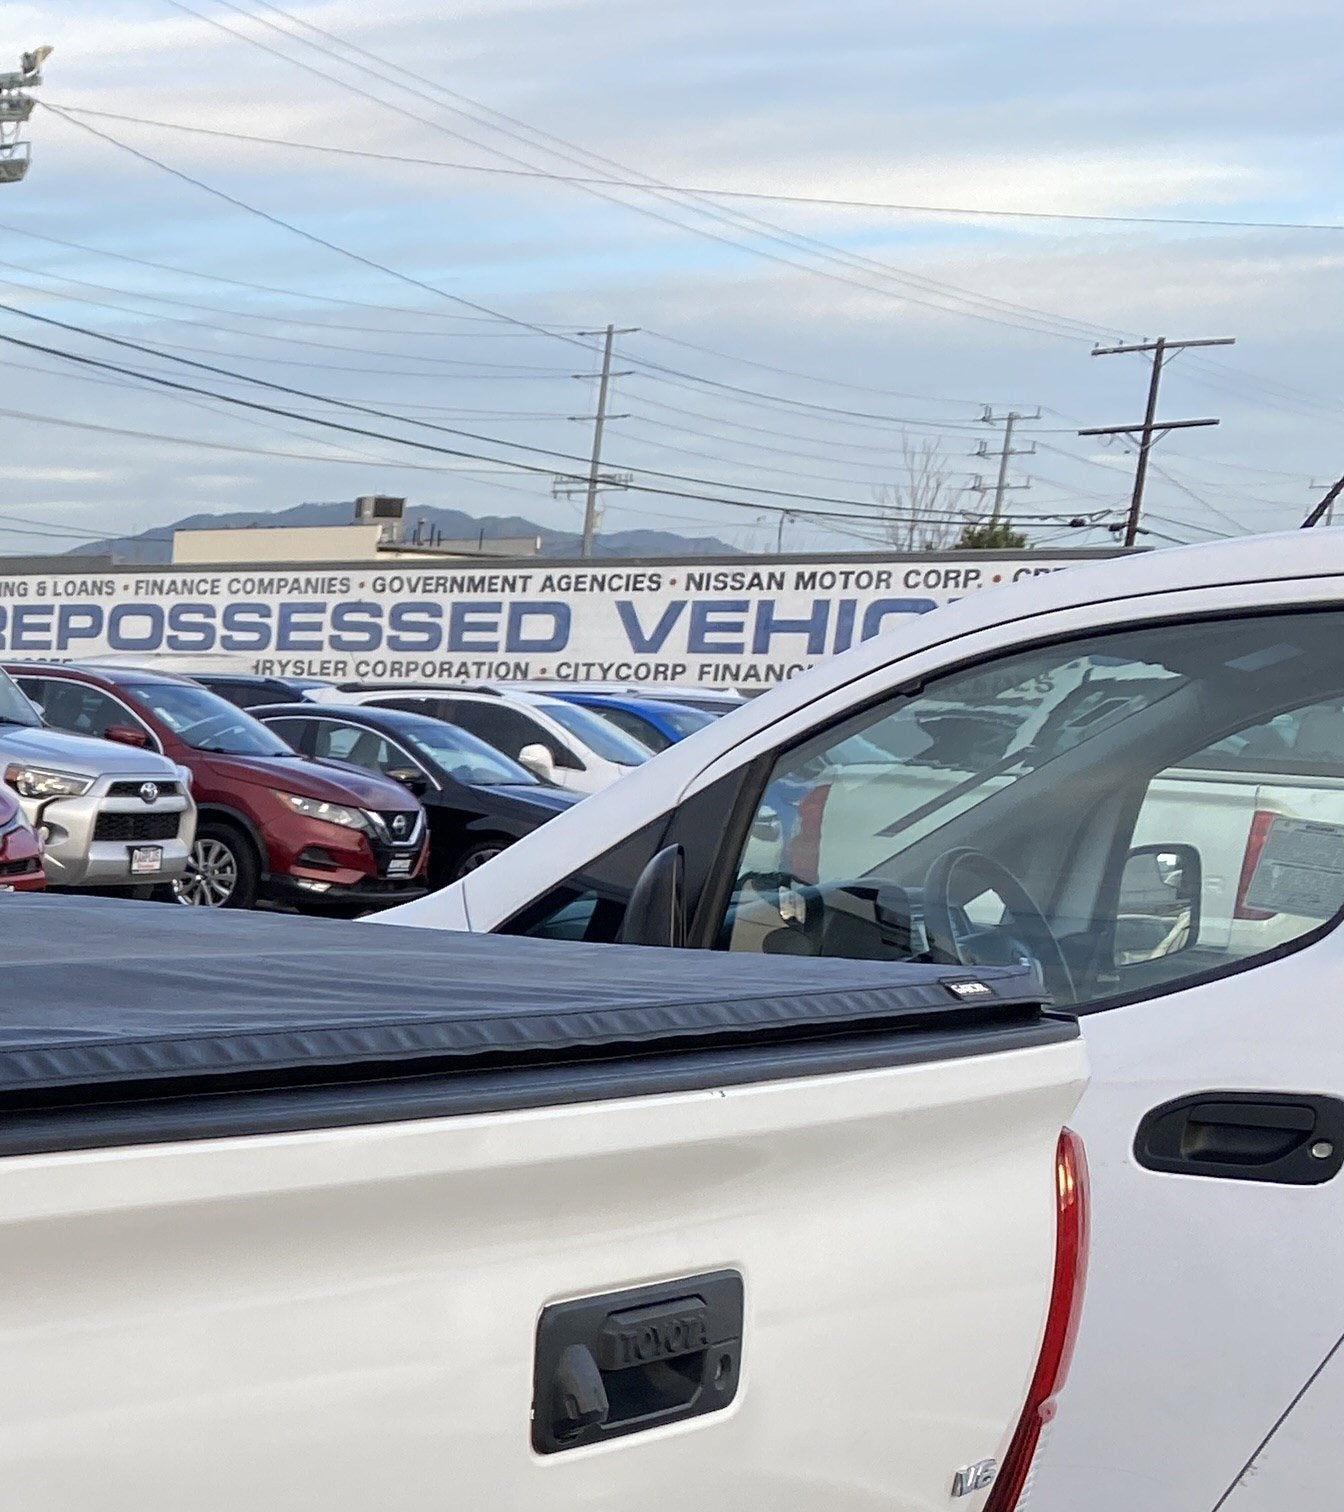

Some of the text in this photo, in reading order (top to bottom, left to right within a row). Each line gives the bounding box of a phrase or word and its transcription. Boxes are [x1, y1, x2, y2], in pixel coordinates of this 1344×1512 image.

[36, 580, 47, 598] &
[52, 579, 116, 597] LOANS
[133, 578, 222, 596] FINANCE
[226, 576, 352, 596] COMPANIES
[371, 574, 533, 595] GOVERNMENT
[538, 573, 662, 593] AGENCIES
[684, 571, 786, 592] NISSAN
[793, 570, 892, 591] MOTOR
[903, 568, 983, 590] CORP.
[355, 660, 530, 681] CORPORATION
[555, 662, 687, 682] CITYCORP
[697, 663, 814, 682] FINANC
